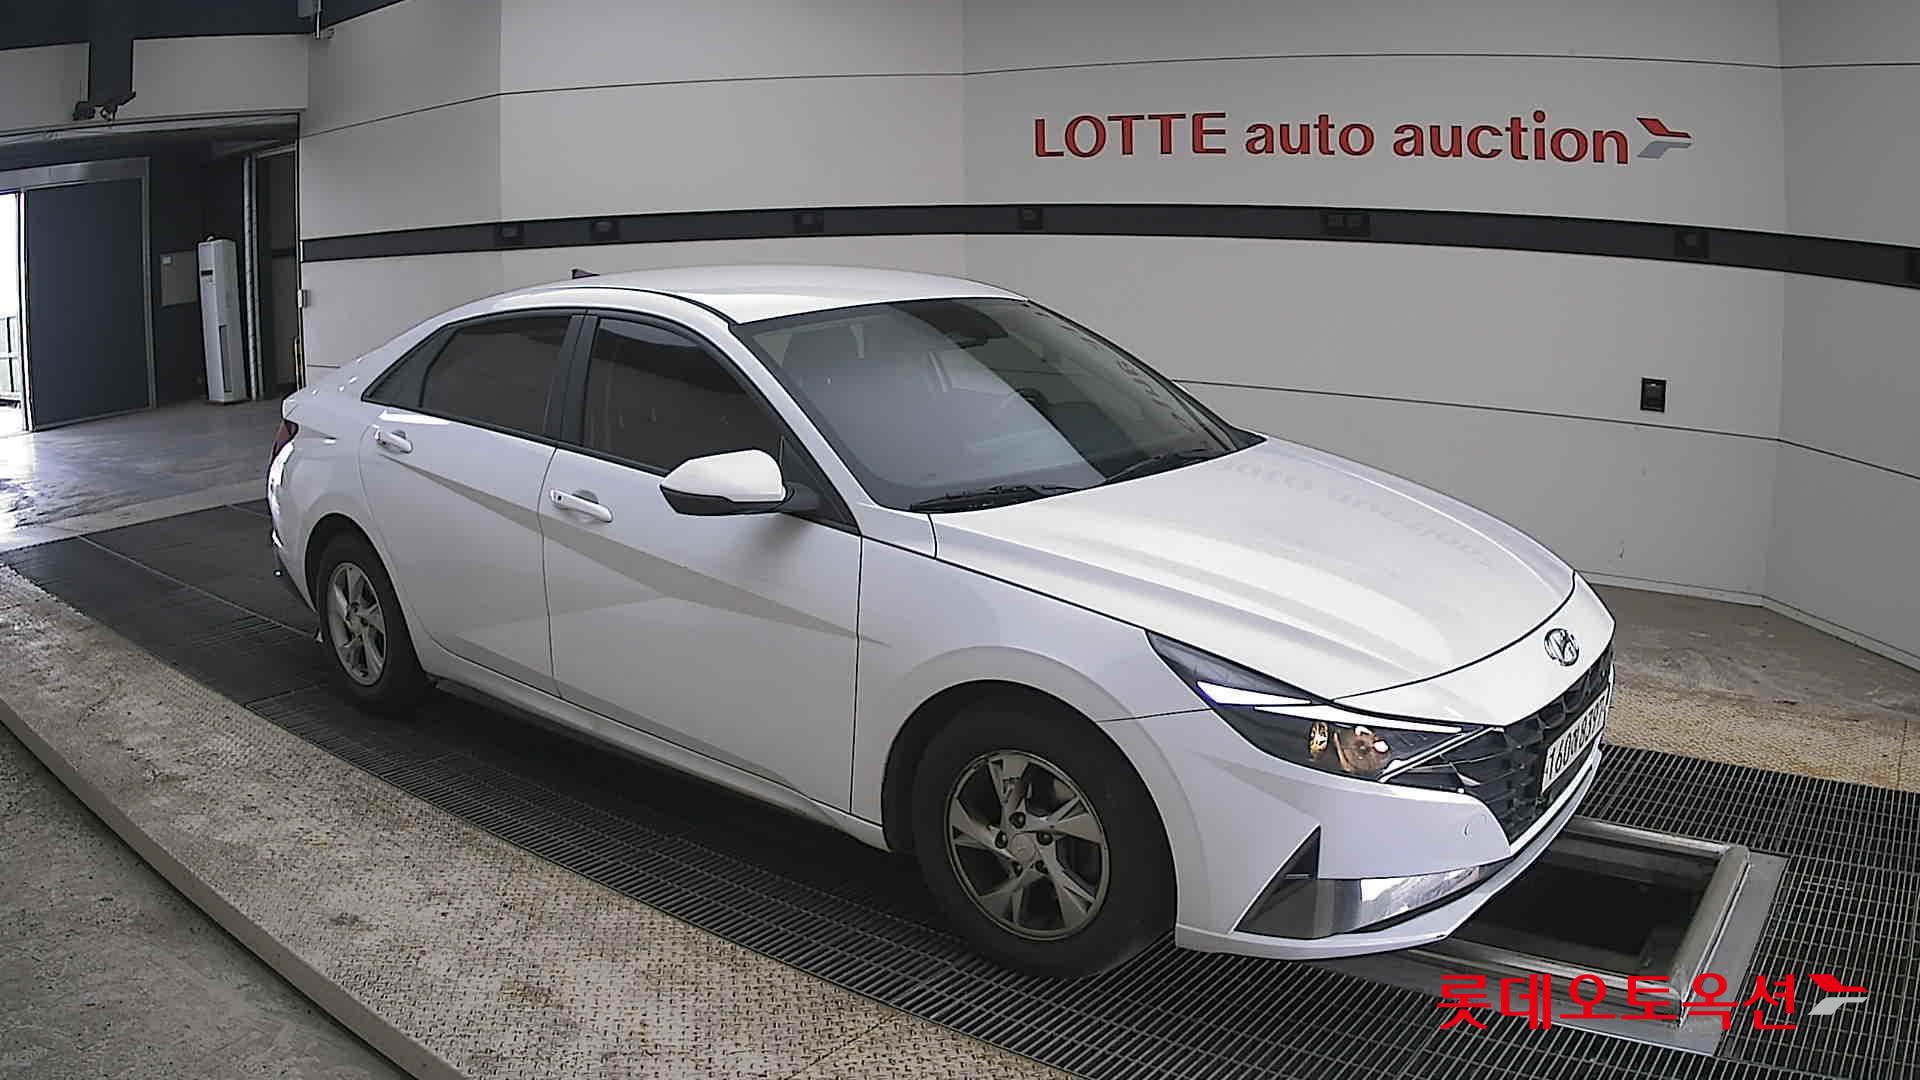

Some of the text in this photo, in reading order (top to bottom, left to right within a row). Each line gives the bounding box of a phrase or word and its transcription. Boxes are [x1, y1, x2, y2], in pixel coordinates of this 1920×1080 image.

[1034, 110, 1629, 165] LOTTE auto auction
